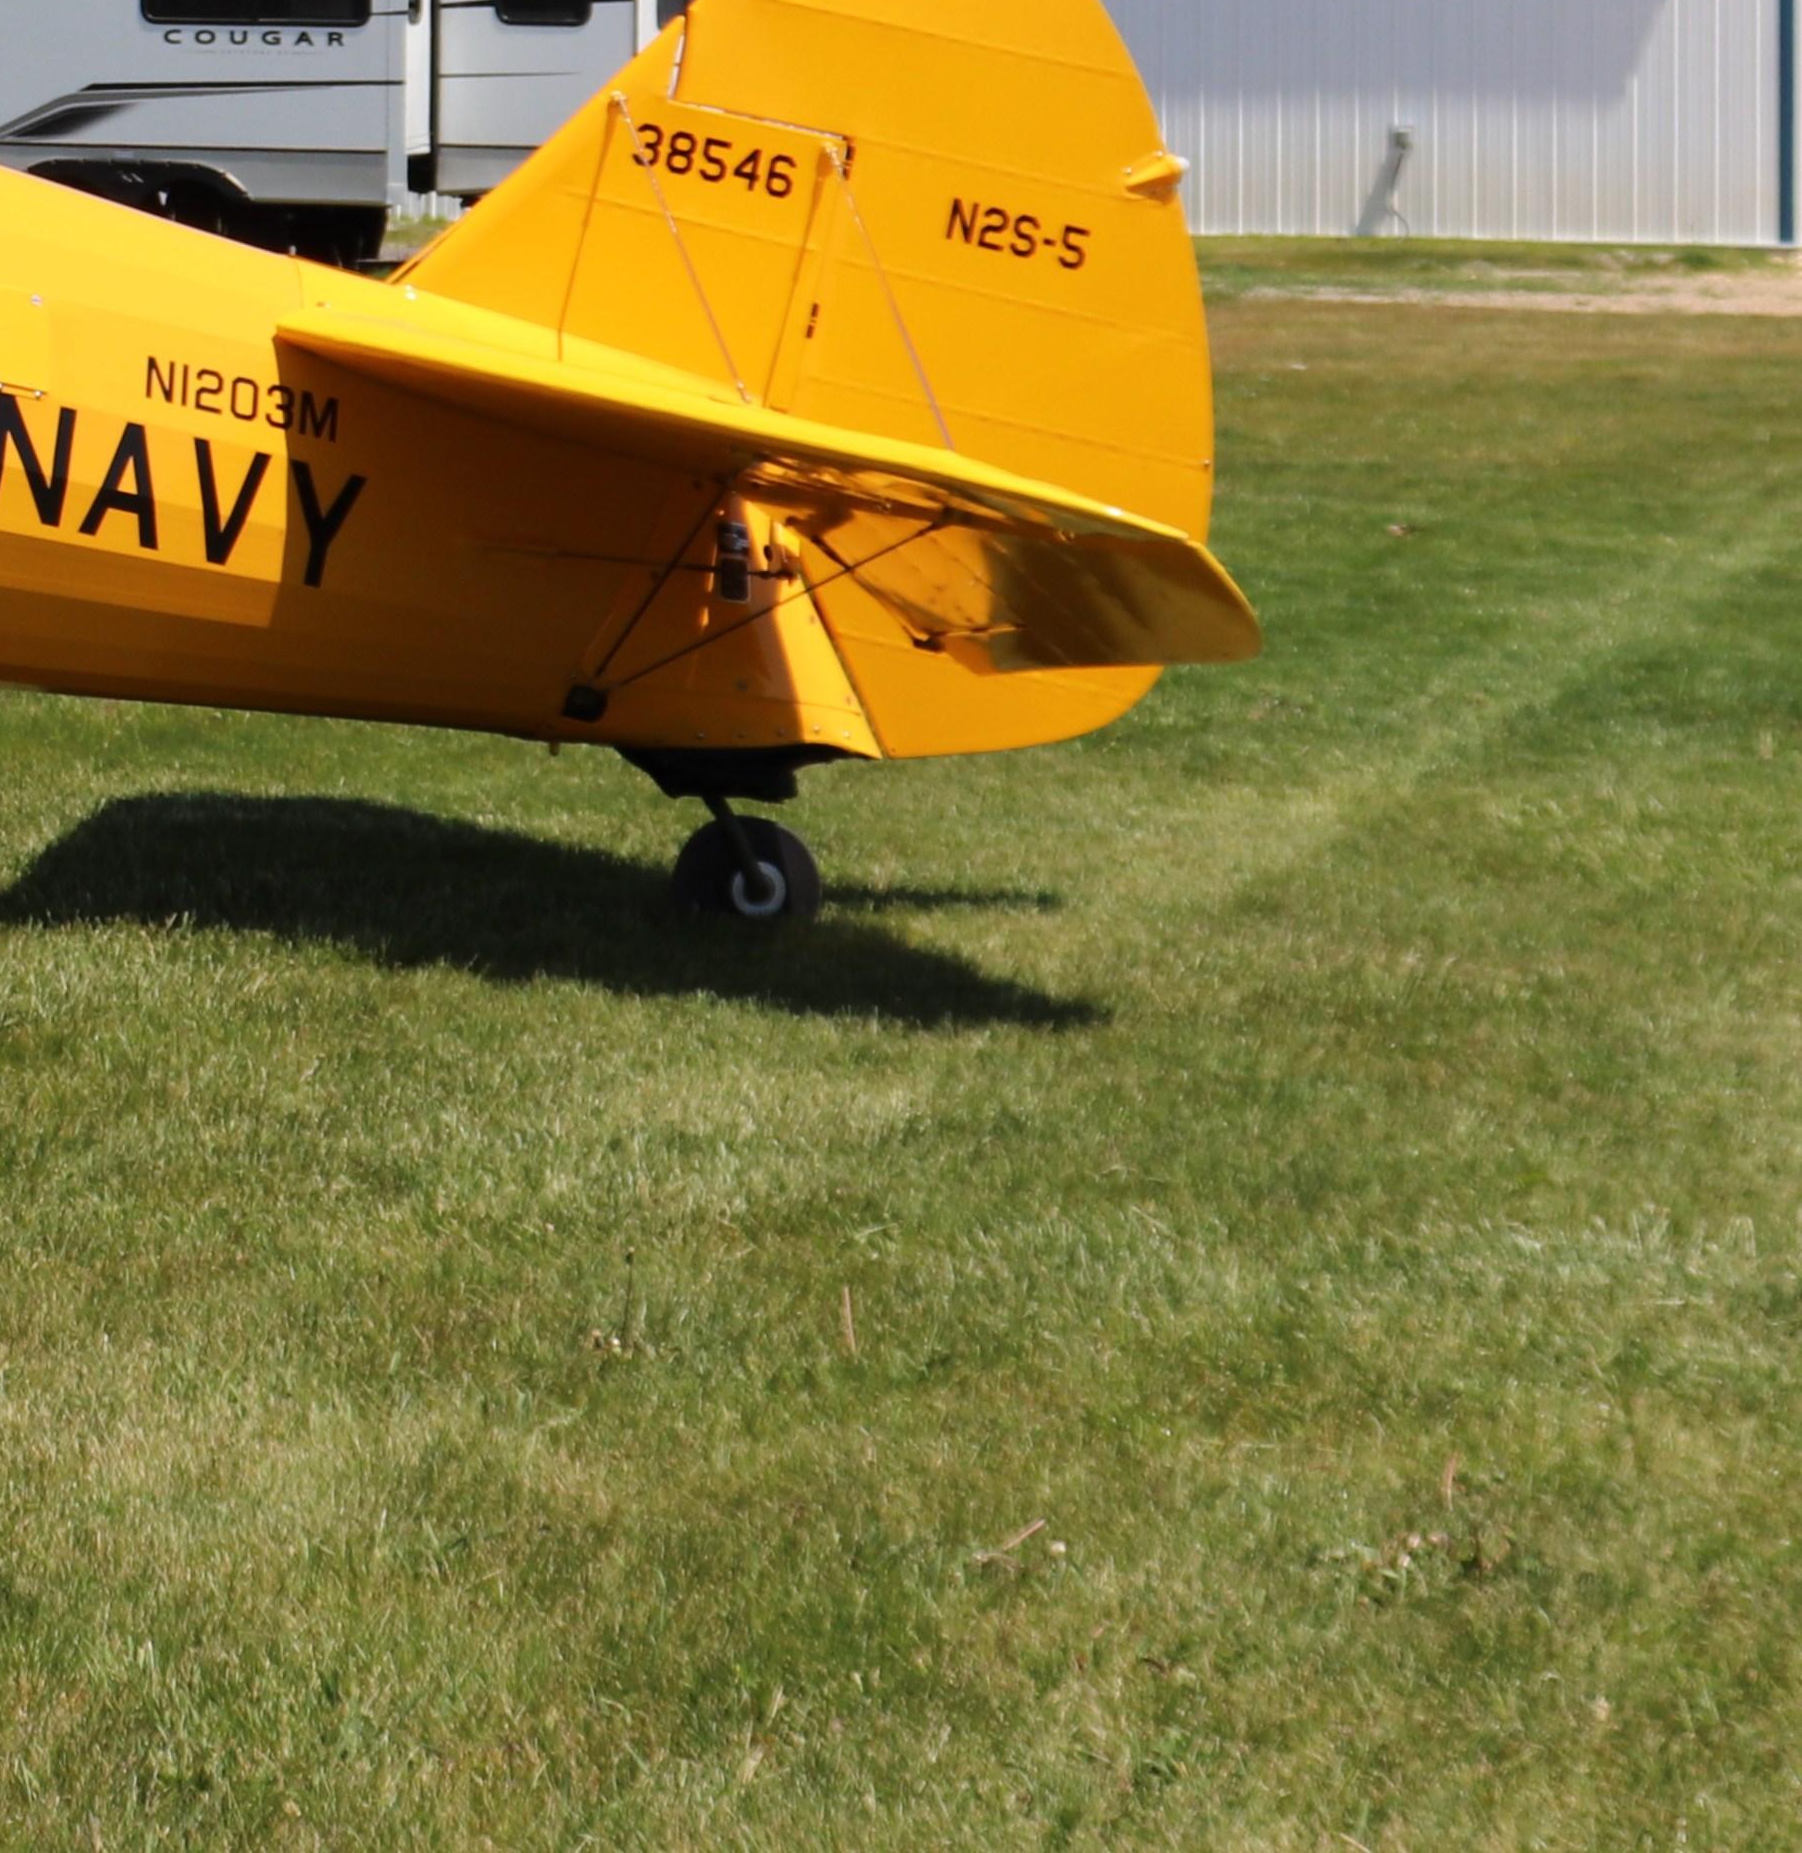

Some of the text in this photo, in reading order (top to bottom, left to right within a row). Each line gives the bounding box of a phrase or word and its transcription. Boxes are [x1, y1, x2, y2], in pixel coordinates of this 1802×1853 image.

[163, 29, 345, 47] COUGAR
[632, 123, 798, 199] 38546
[946, 198, 1091, 269] N2S-5
[147, 356, 340, 443] N1203M
